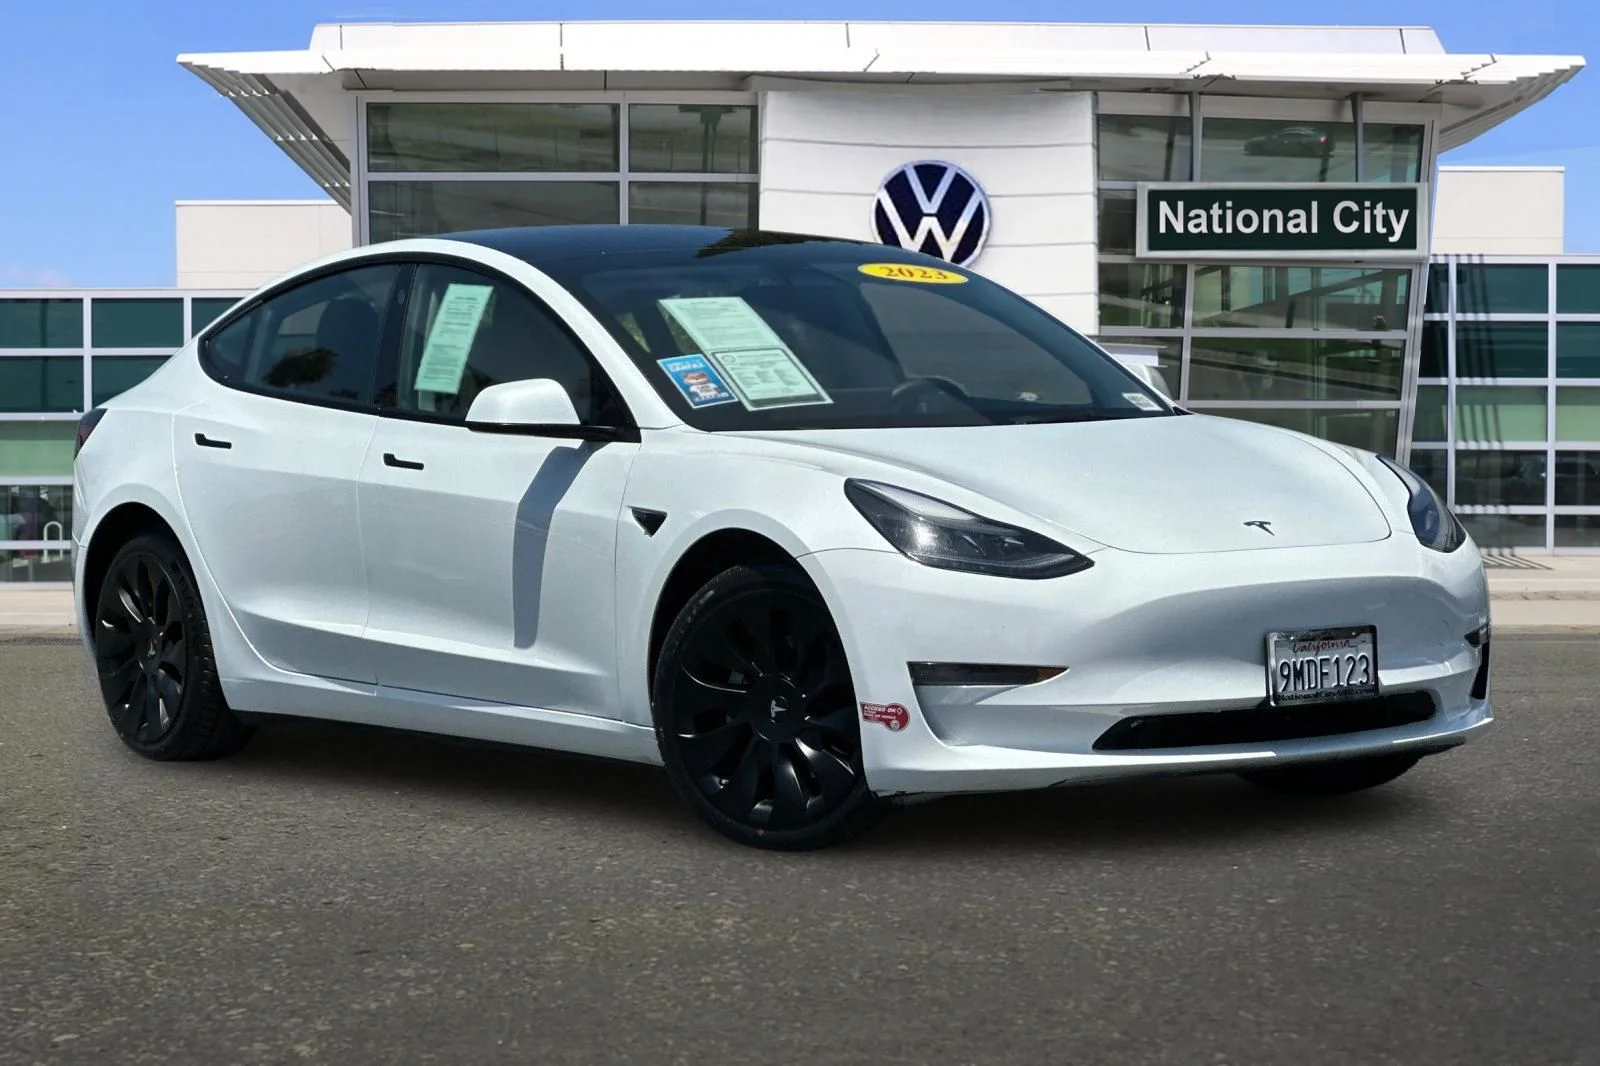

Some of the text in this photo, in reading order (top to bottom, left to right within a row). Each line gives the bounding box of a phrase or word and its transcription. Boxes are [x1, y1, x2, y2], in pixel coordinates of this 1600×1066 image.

[874, 163, 987, 263] VW
[1158, 200, 1410, 243] National City
[880, 266, 948, 280] 2023
[1293, 639, 1356, 656] California
[1279, 652, 1370, 692] 9MDF123
